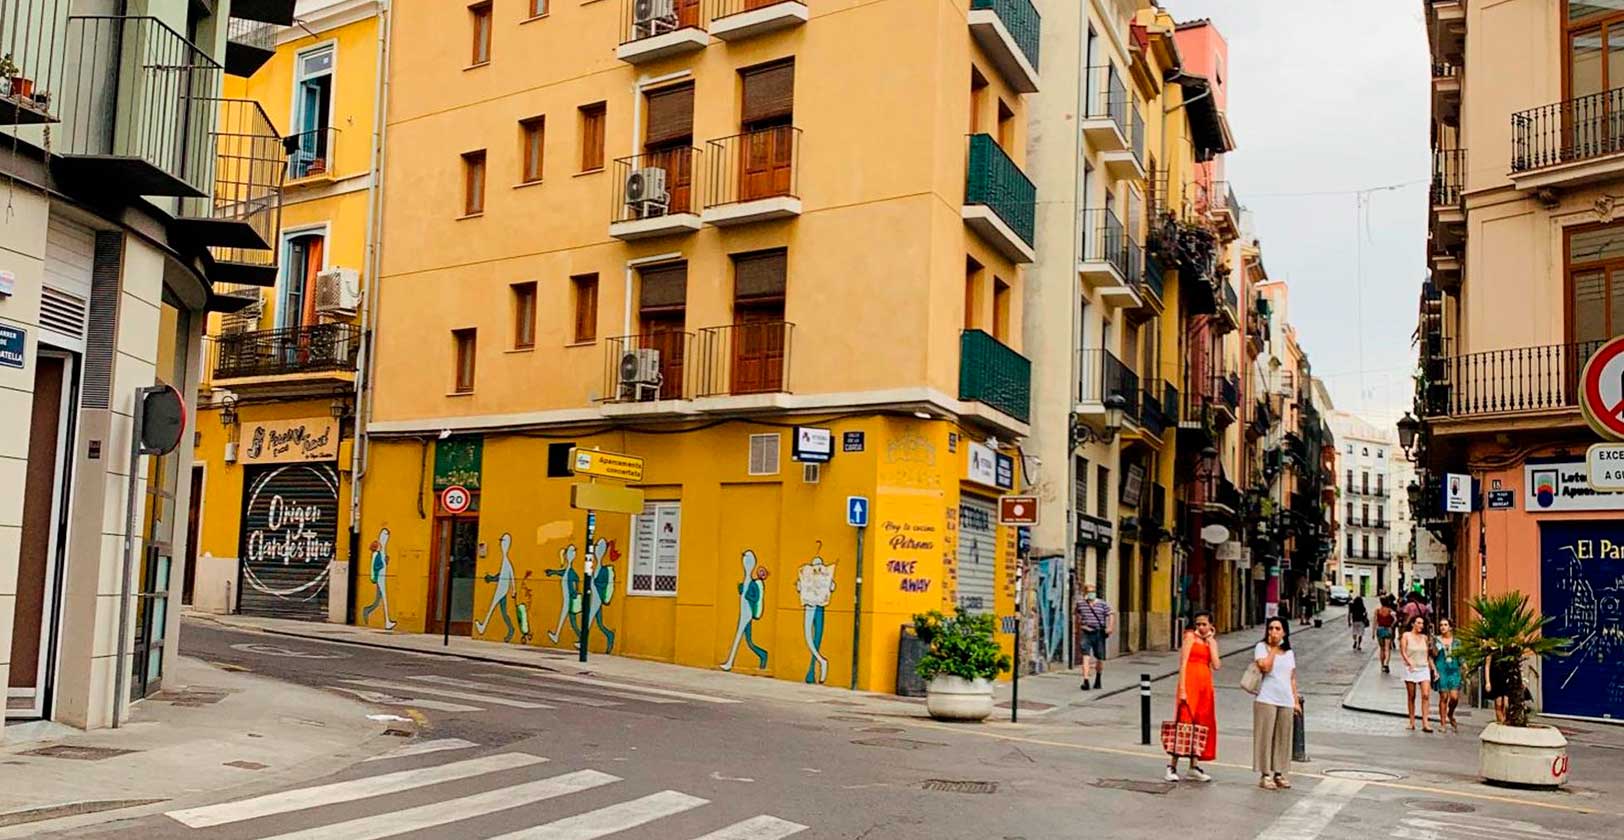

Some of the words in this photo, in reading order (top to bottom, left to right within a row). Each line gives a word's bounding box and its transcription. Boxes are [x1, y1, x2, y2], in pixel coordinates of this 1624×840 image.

[1605, 471, 1612, 480] A
[448, 495, 463, 504] 20
[268, 495, 321, 540] Origen
[1577, 540, 1594, 559] El
[886, 560, 918, 574] TAKE
[900, 579, 931, 592] AWAY
